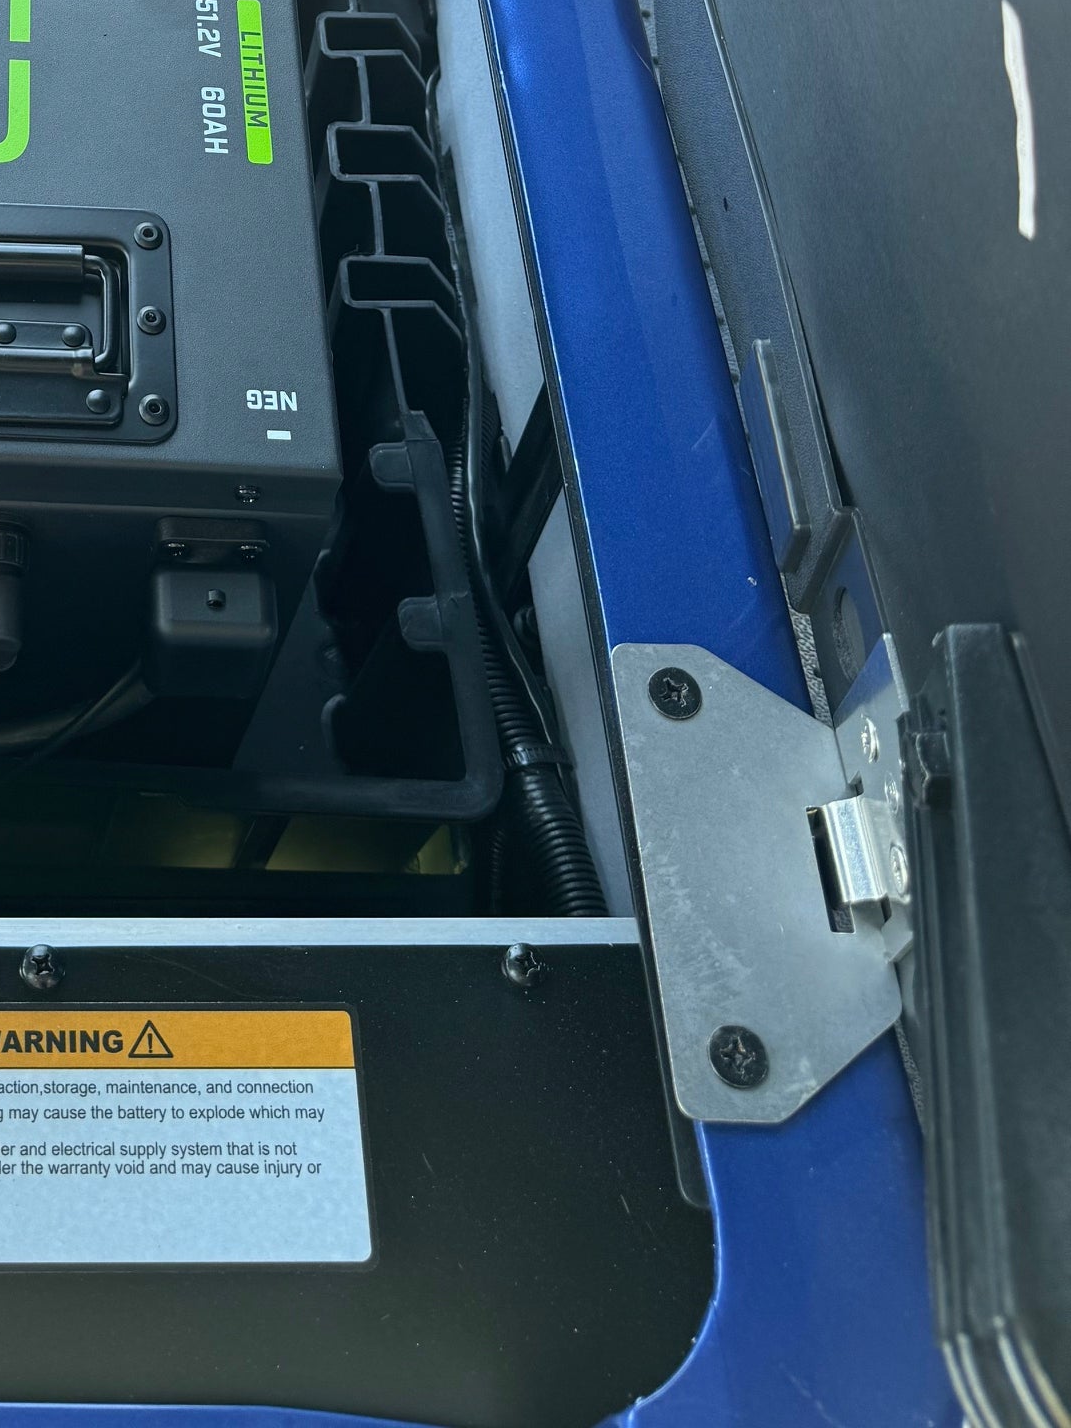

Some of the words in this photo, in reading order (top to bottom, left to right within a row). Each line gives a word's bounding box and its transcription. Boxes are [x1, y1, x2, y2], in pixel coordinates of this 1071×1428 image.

[196, 0, 221, 57] 51.2V
[241, 31, 268, 128] LITHIUM
[201, 87, 228, 153] 60AH
[246, 389, 298, 412] NEG
[105, 1079, 202, 1097] maintenance,
[205, 1079, 233, 1095] and
[236, 1079, 314, 1094] connection
[8, 1108, 40, 1124] may
[43, 1108, 87, 1120] cause
[90, 1104, 114, 1120] the
[117, 1104, 167, 1124] battery
[170, 1105, 185, 1120] to
[188, 1104, 246, 1123] explode
[248, 1104, 291, 1120] which
[294, 1107, 325, 1123] may
[19, 1141, 47, 1157] and
[51, 1141, 116, 1157] electrical
[119, 1140, 167, 1160] supply
[170, 1141, 223, 1160] system
[225, 1141, 255, 1156] that
[257, 1140, 271, 1156] is
[274, 1141, 298, 1156] not
[20, 1159, 44, 1175] the
[47, 1160, 111, 1179] warranty
[114, 1159, 145, 1175] void
[149, 1159, 177, 1175] and
[181, 1162, 212, 1179] may
[216, 1162, 260, 1175] cause
[263, 1159, 303, 1179] injury
[307, 1162, 322, 1175] or
